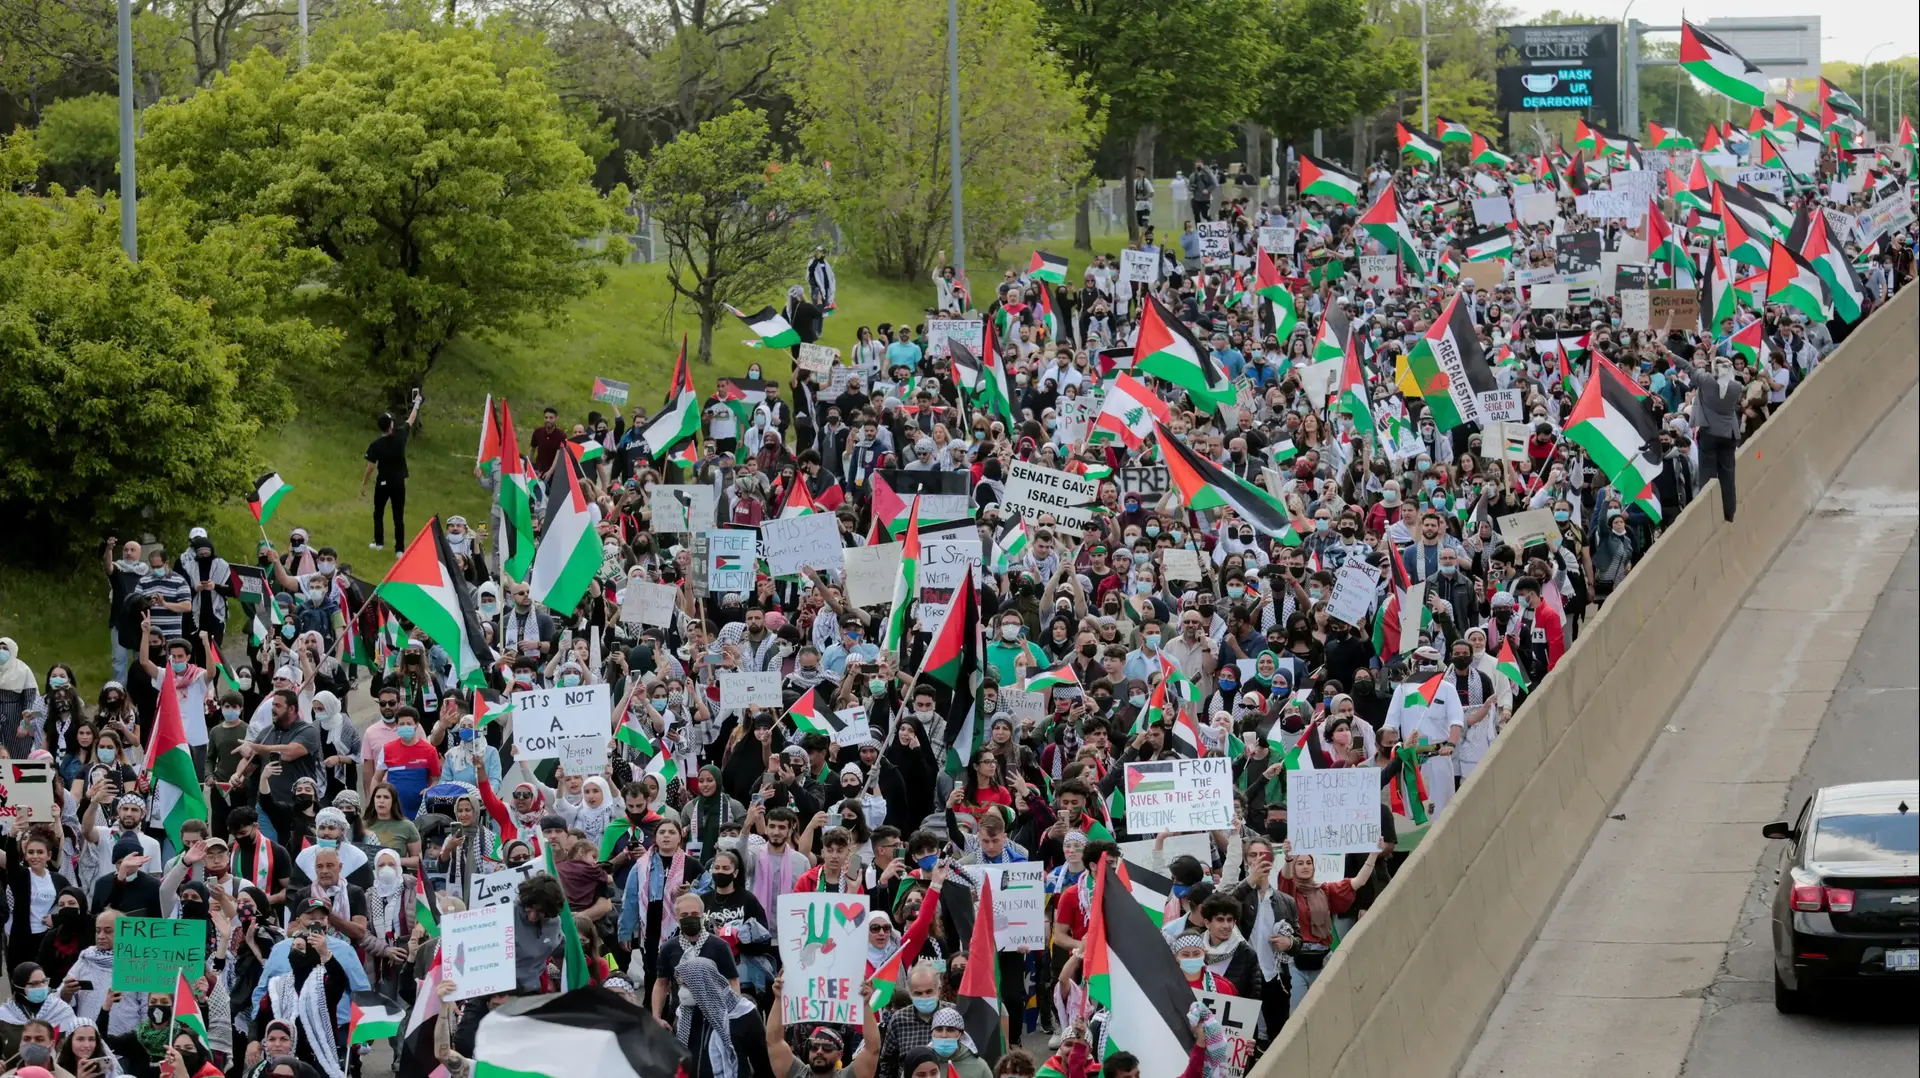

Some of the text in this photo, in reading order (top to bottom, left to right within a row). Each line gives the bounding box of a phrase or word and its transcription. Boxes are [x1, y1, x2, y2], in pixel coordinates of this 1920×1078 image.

[1525, 43, 1589, 58] CENTER
[1558, 69, 1592, 80] MASK
[1569, 83, 1589, 94] UP,
[1522, 95, 1592, 108] DEARBORN!
[932, 321, 970, 331] RESPECT
[1436, 339, 1478, 419] FREE PALESTINE
[1485, 392, 1512, 402] END THE
[1484, 401, 1515, 412] SEIGE ON
[1491, 412, 1510, 421] GAZA
[1011, 466, 1095, 497] SENATE GAVE
[1121, 466, 1170, 493] FRE
[1027, 489, 1070, 509] ISRAEL
[761, 519, 800, 541] THIS
[713, 536, 750, 551] FREE
[922, 544, 939, 566] I
[925, 572, 950, 584] WITH
[725, 675, 775, 689] END THE
[520, 689, 595, 711] IT'S NOT
[724, 691, 782, 705] OCCUPATION
[1005, 690, 1029, 700] FREE
[1010, 699, 1043, 711] ESTINE!
[550, 715, 562, 733] A
[563, 743, 593, 759] YEMEN
[1178, 759, 1227, 777] FROM
[1191, 777, 1212, 788] THE
[1291, 775, 1314, 792] THE
[1316, 772, 1359, 789] ROCKETS
[1130, 788, 1221, 807] RIVER TO THE SEA
[1296, 791, 1371, 811] BE ABOVE US
[1129, 808, 1177, 829] PALESTINE
[120, 920, 190, 939] FREE
[452, 920, 497, 934] RESISTANCE
[468, 942, 501, 953] REFUSAL
[505, 925, 514, 961] RIVER
[117, 942, 201, 963] PALESTINE
[469, 962, 501, 973] RETURN
[808, 976, 850, 1001] FREE
[783, 994, 858, 1023] PALESTINE
[1225, 1028, 1240, 1037] the
